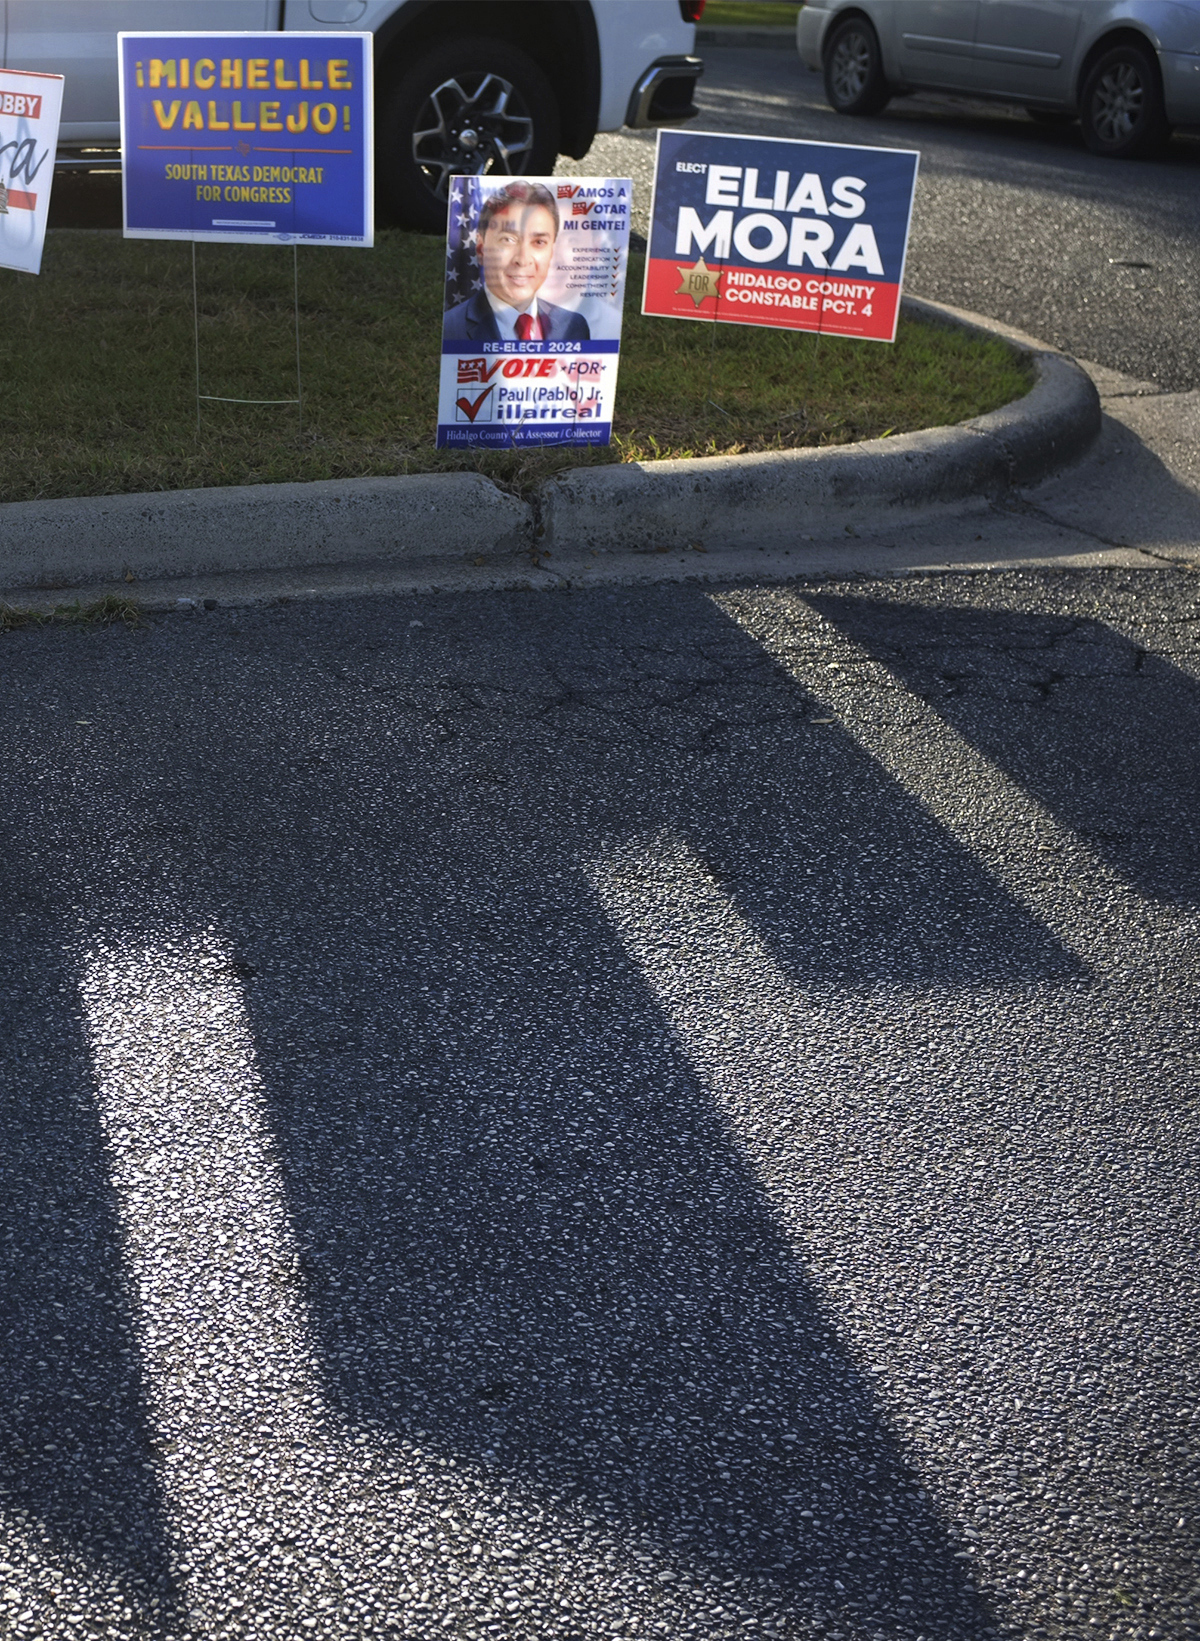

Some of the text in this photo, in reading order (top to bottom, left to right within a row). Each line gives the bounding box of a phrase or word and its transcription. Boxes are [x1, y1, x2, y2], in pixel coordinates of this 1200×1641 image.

[152, 100, 351, 134] VALLEJO!
[165, 164, 323, 183] SOUTH TEXAS DEMOCRAT
[676, 161, 707, 174] ELECT
[196, 185, 291, 203] FOR CONGRESS
[618, 188, 626, 197] A
[705, 164, 867, 219] ELIAS
[564, 220, 625, 230] MI GENTE!
[675, 206, 885, 276] MORA
[688, 274, 709, 292] FOR
[727, 271, 875, 300] HIDALGO COUNTY
[725, 288, 873, 317] CONSTABLE PCT. 4
[483, 342, 581, 352] RE-ELECT 2024
[568, 362, 599, 374] FOR
[499, 386, 604, 404] Paul (Pablo) Jr.
[446, 429, 478, 443] Hidalgo
[479, 429, 508, 442] County
[525, 427, 559, 440] Assessor
[566, 427, 603, 439] Collector
